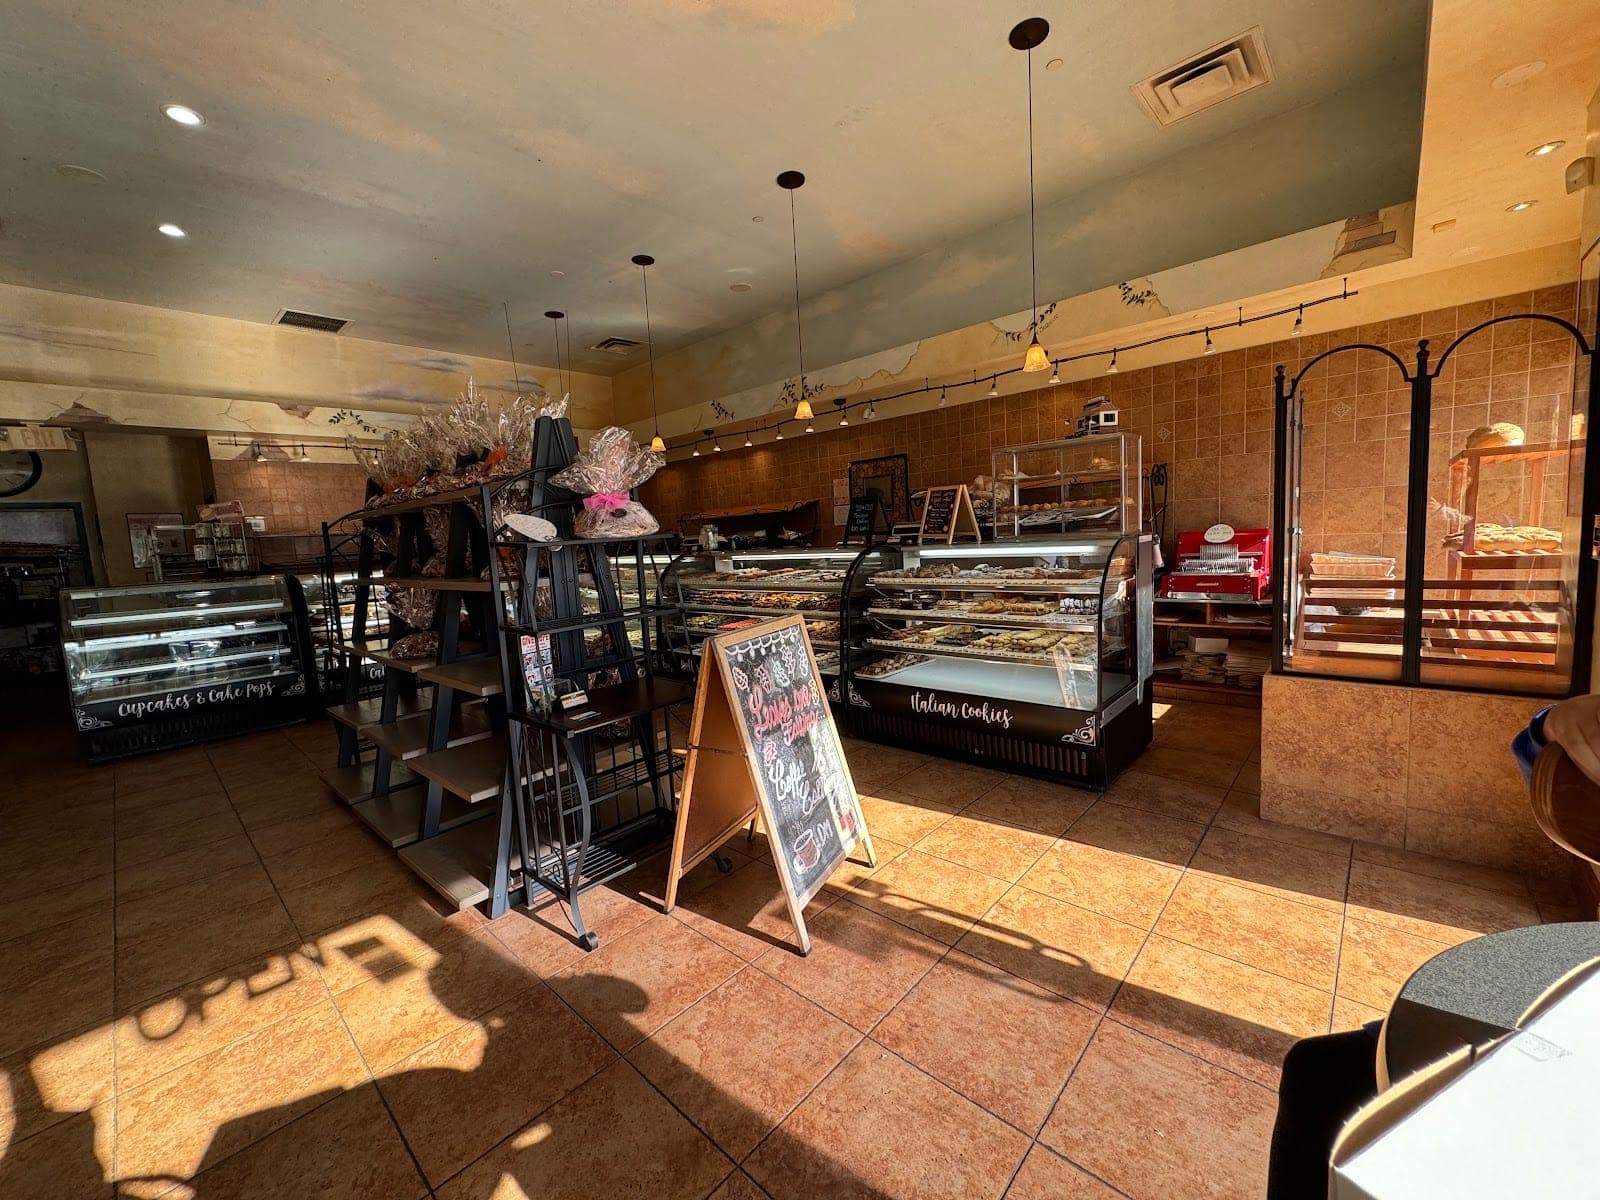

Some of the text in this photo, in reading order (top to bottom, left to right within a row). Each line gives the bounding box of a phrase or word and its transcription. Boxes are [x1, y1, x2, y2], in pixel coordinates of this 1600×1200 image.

[118, 681, 275, 718] Cupcakes & Cake Pops
[911, 691, 1014, 729] Italian Cookies
